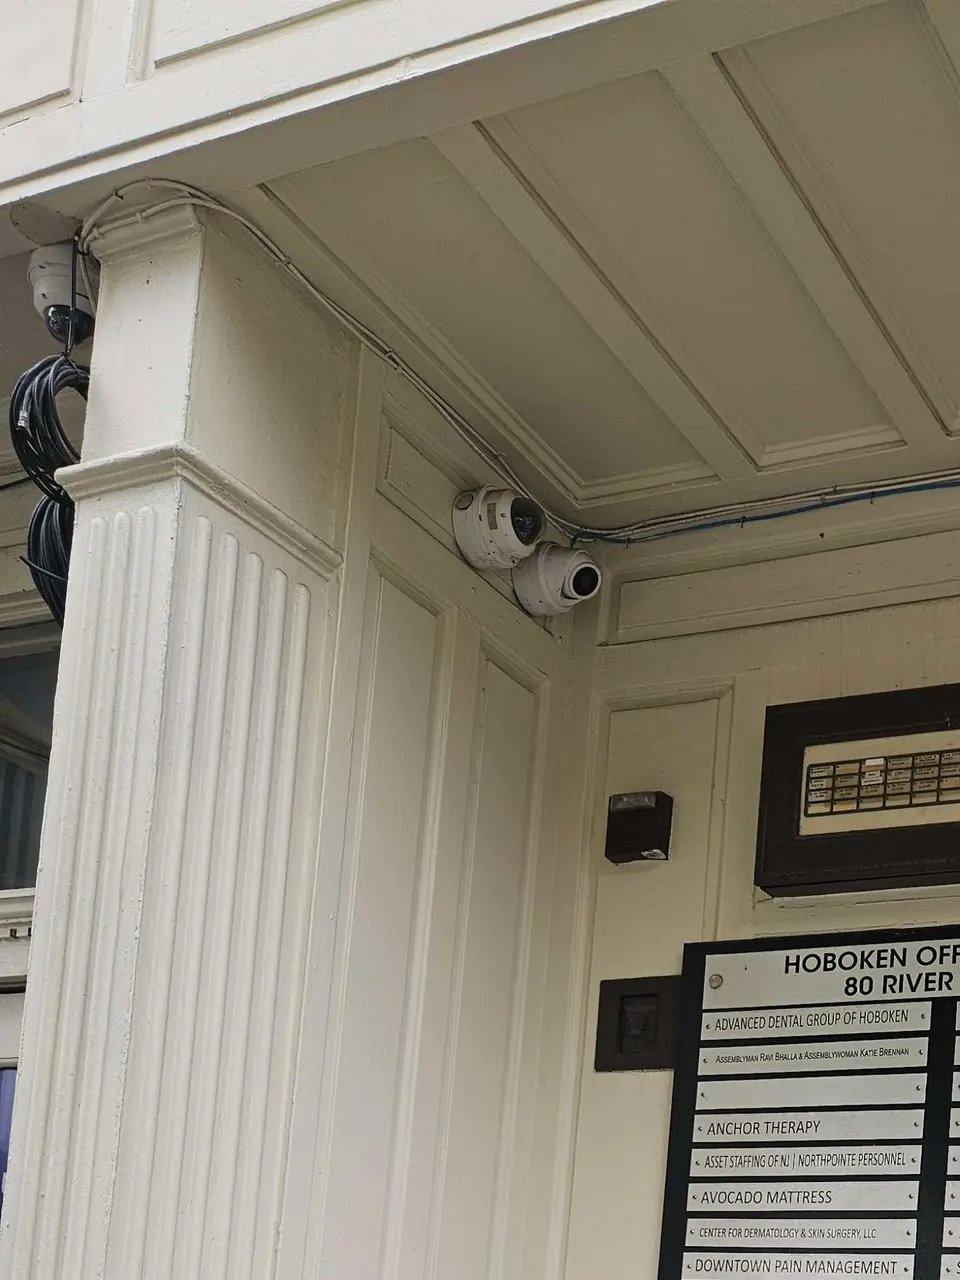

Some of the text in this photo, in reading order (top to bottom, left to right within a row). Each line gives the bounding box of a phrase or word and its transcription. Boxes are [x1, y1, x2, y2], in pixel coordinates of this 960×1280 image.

[783, 948, 908, 975] HOBOKEN
[844, 976, 873, 996] 80
[883, 972, 955, 997] RIVER
[715, 1009, 908, 1031] ADVANCED DENTAL GROUP OF HOBOKEN
[707, 1121, 820, 1135] ANCHOR THERAPY
[704, 1156, 728, 1168] ASSET
[729, 1155, 765, 1168] STAFFING
[768, 1155, 779, 1167] OF
[781, 1155, 789, 1167] NJ
[798, 1154, 856, 1167] NORTHPOINTE
[858, 1153, 905, 1166] PERSONNEL
[701, 1191, 831, 1204] AVOCADO MATTRESS
[700, 1228, 876, 1240] CENTER FOR DERMATOLOGY & SKIN SURGERY, LLC
[696, 1259, 897, 1274] DOWNTOWN PAIN MANAGEMENT
